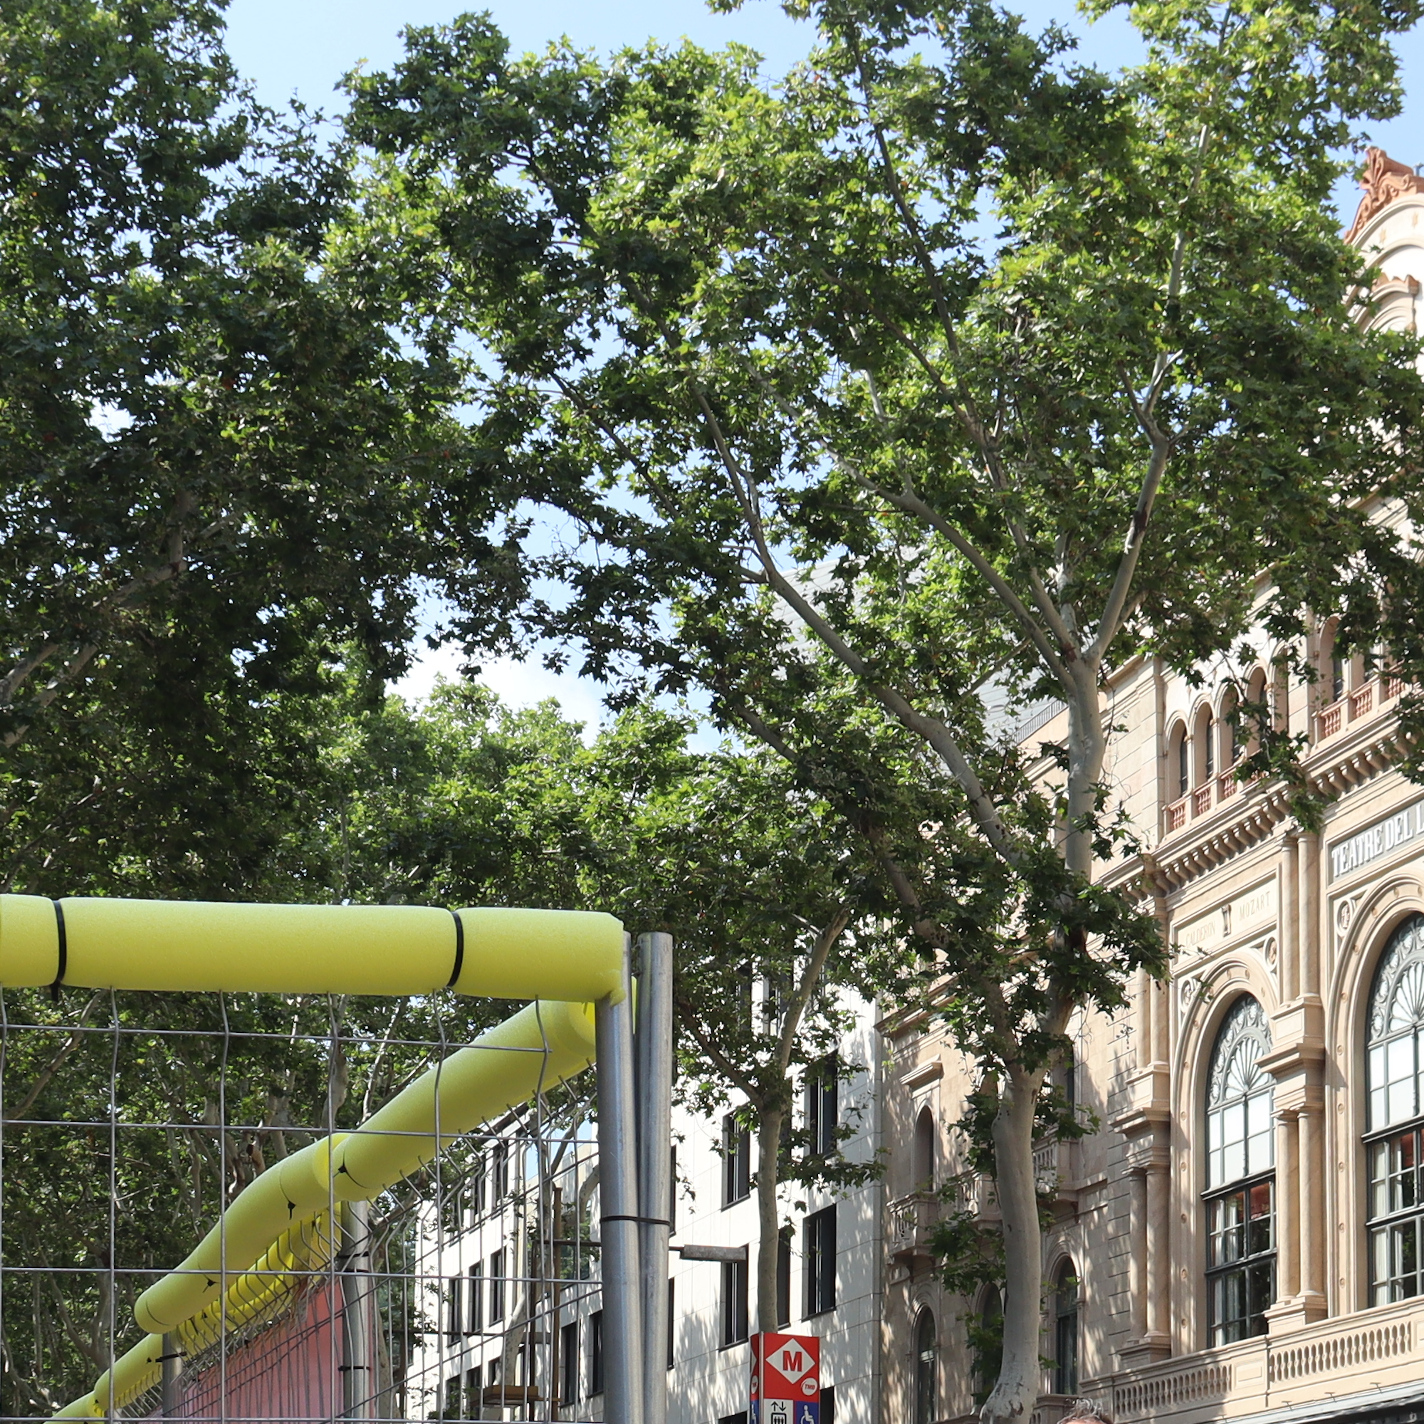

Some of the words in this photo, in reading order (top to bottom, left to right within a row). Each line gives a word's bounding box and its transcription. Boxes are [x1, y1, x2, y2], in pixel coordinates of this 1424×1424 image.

[1331, 825, 1384, 878] TEATRE
[1385, 810, 1414, 851] DEL
[1239, 891, 1271, 921] MOZART
[783, 1350, 803, 1372] M
